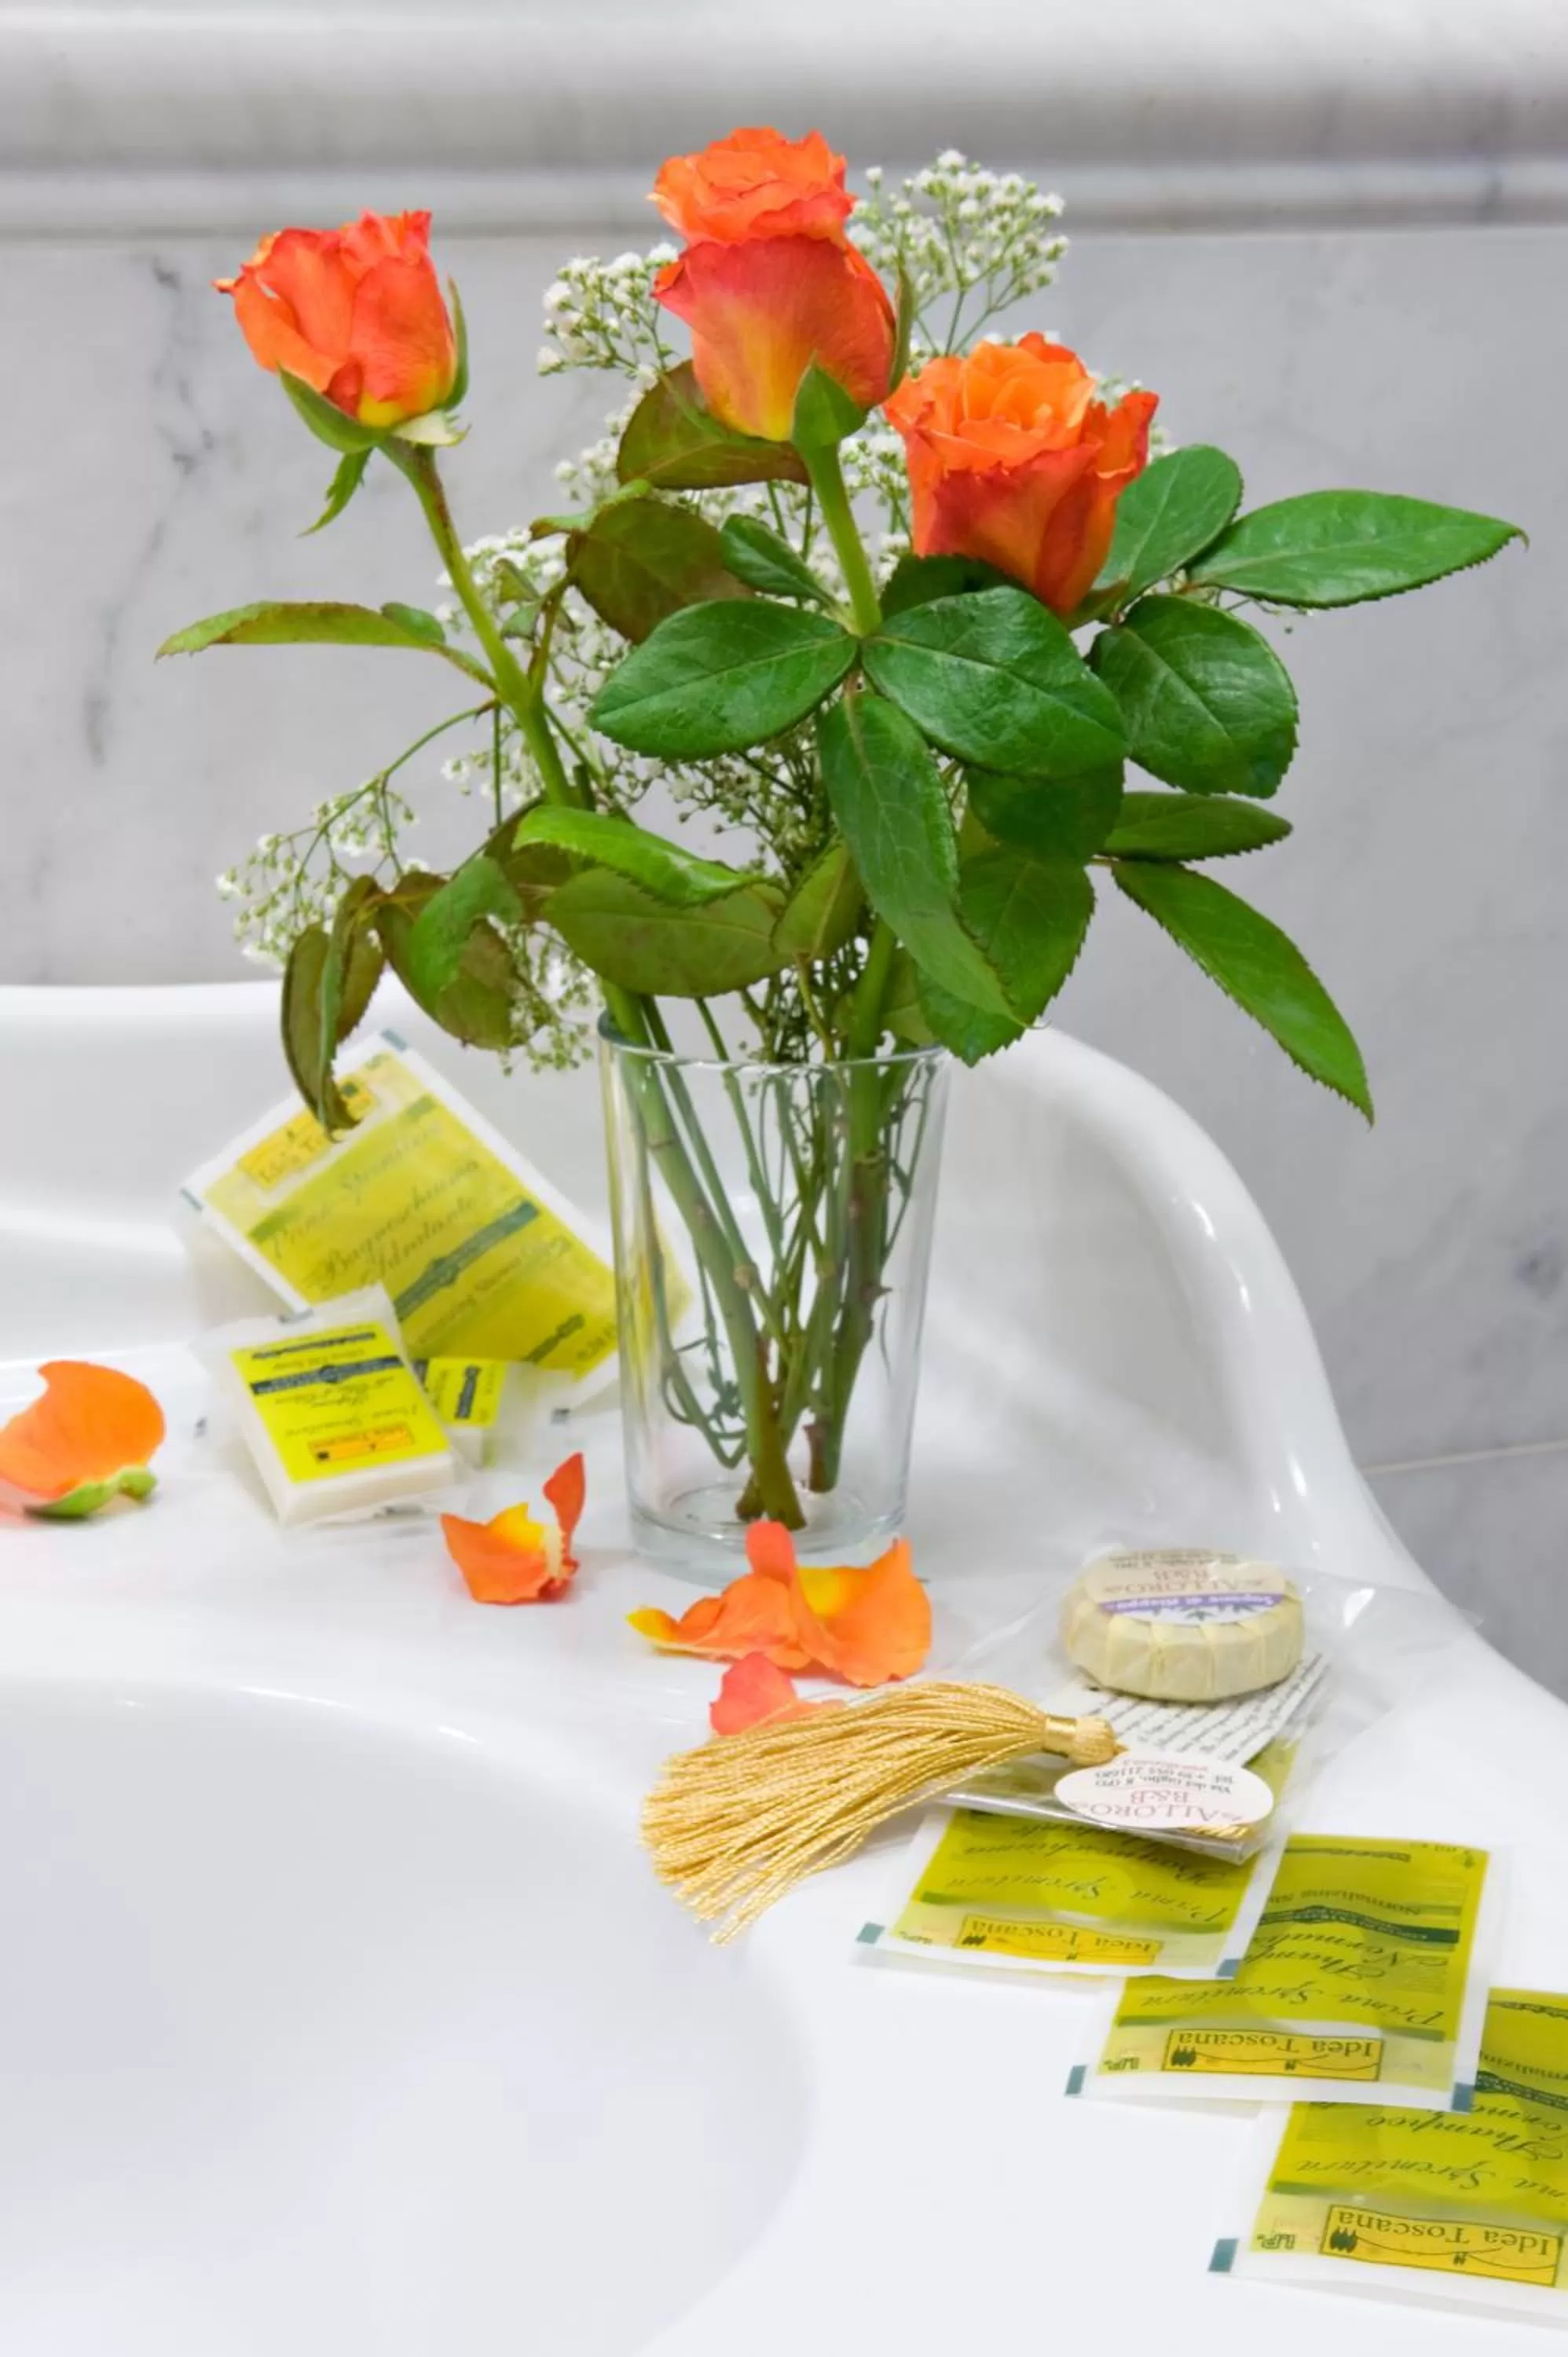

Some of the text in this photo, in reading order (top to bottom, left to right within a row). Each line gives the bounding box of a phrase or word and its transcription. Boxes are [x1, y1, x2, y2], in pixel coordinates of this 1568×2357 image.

[944, 1875, 1107, 1901] Spremitura
[1131, 1888, 1229, 1925] Prima
[970, 1919, 1084, 1952] Toscana
[1138, 1981, 1445, 2025] Prima Spremitura
[1177, 2030, 1375, 2058] Idea Toscana
[1366, 2110, 1564, 2162] Shampoo
[1295, 2158, 1497, 2191] Spremitura
[1337, 2210, 1550, 2256] Idea Toscana
